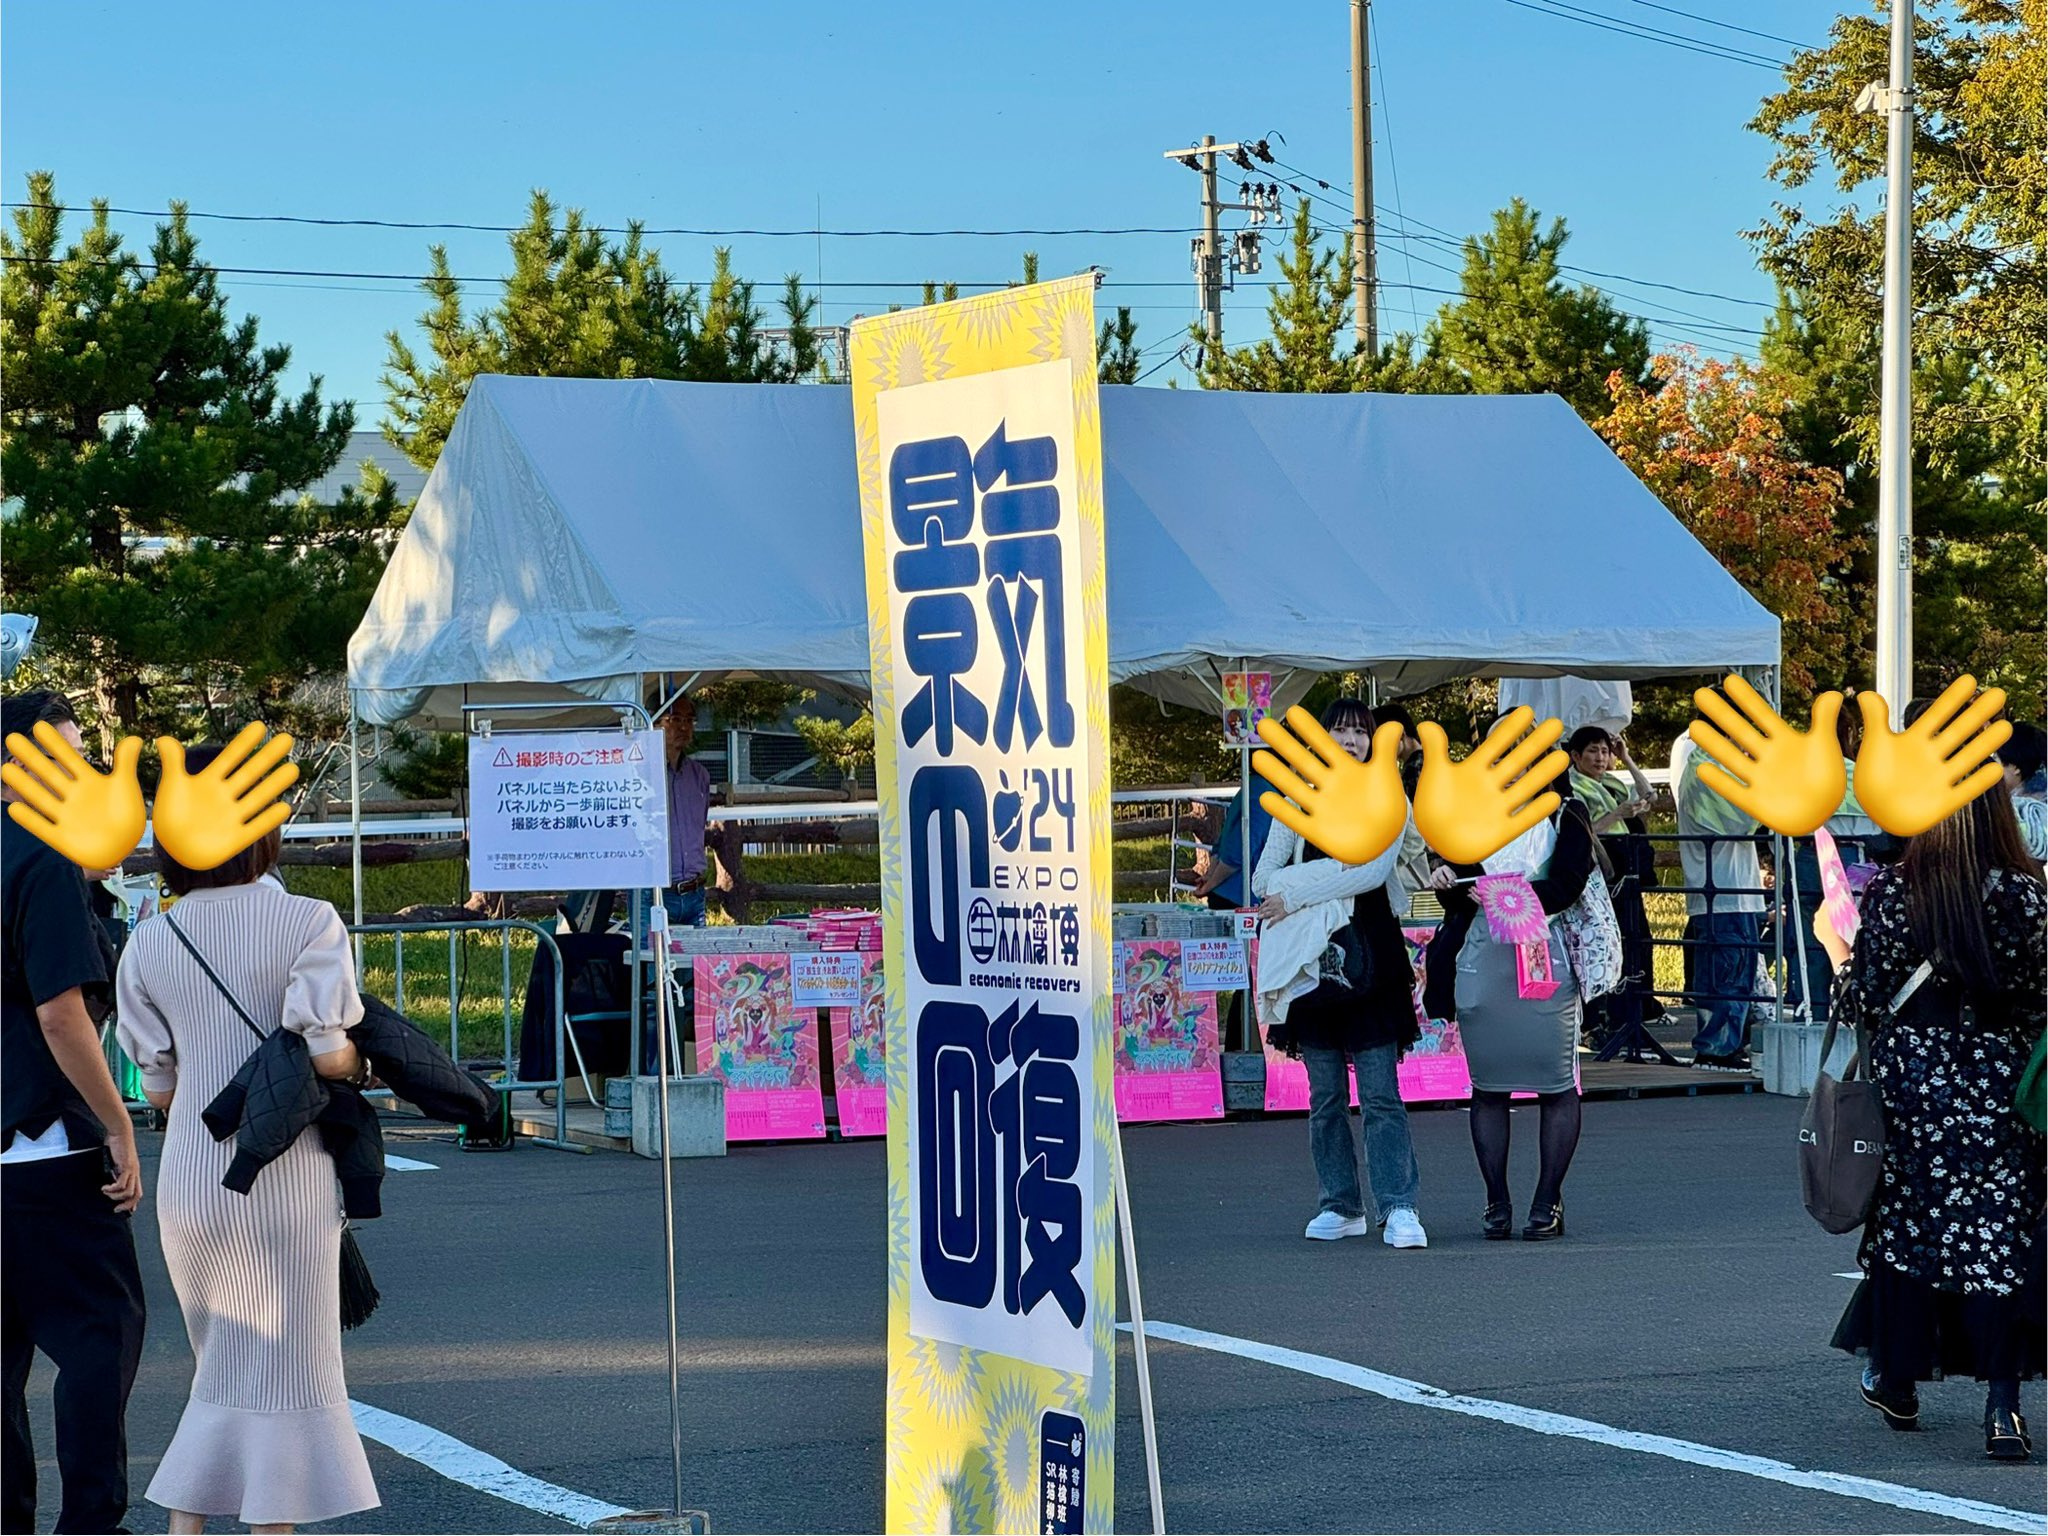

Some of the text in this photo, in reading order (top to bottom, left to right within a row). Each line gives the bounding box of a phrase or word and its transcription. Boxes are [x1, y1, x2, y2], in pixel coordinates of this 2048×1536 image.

[889, 417, 1075, 758] 景気
[516, 748, 625, 768] 撮影時のご注意
[497, 778, 648, 796] パネルに当たらないよう、
[497, 796, 643, 814] パネルから一歩前に出て
[511, 813, 638, 831] 撮影をお願いします。
[493, 862, 549, 871] ご注意ください。
[909, 764, 991, 987] の
[994, 865, 1079, 891] EXPO
[969, 972, 1080, 993] economic recovery
